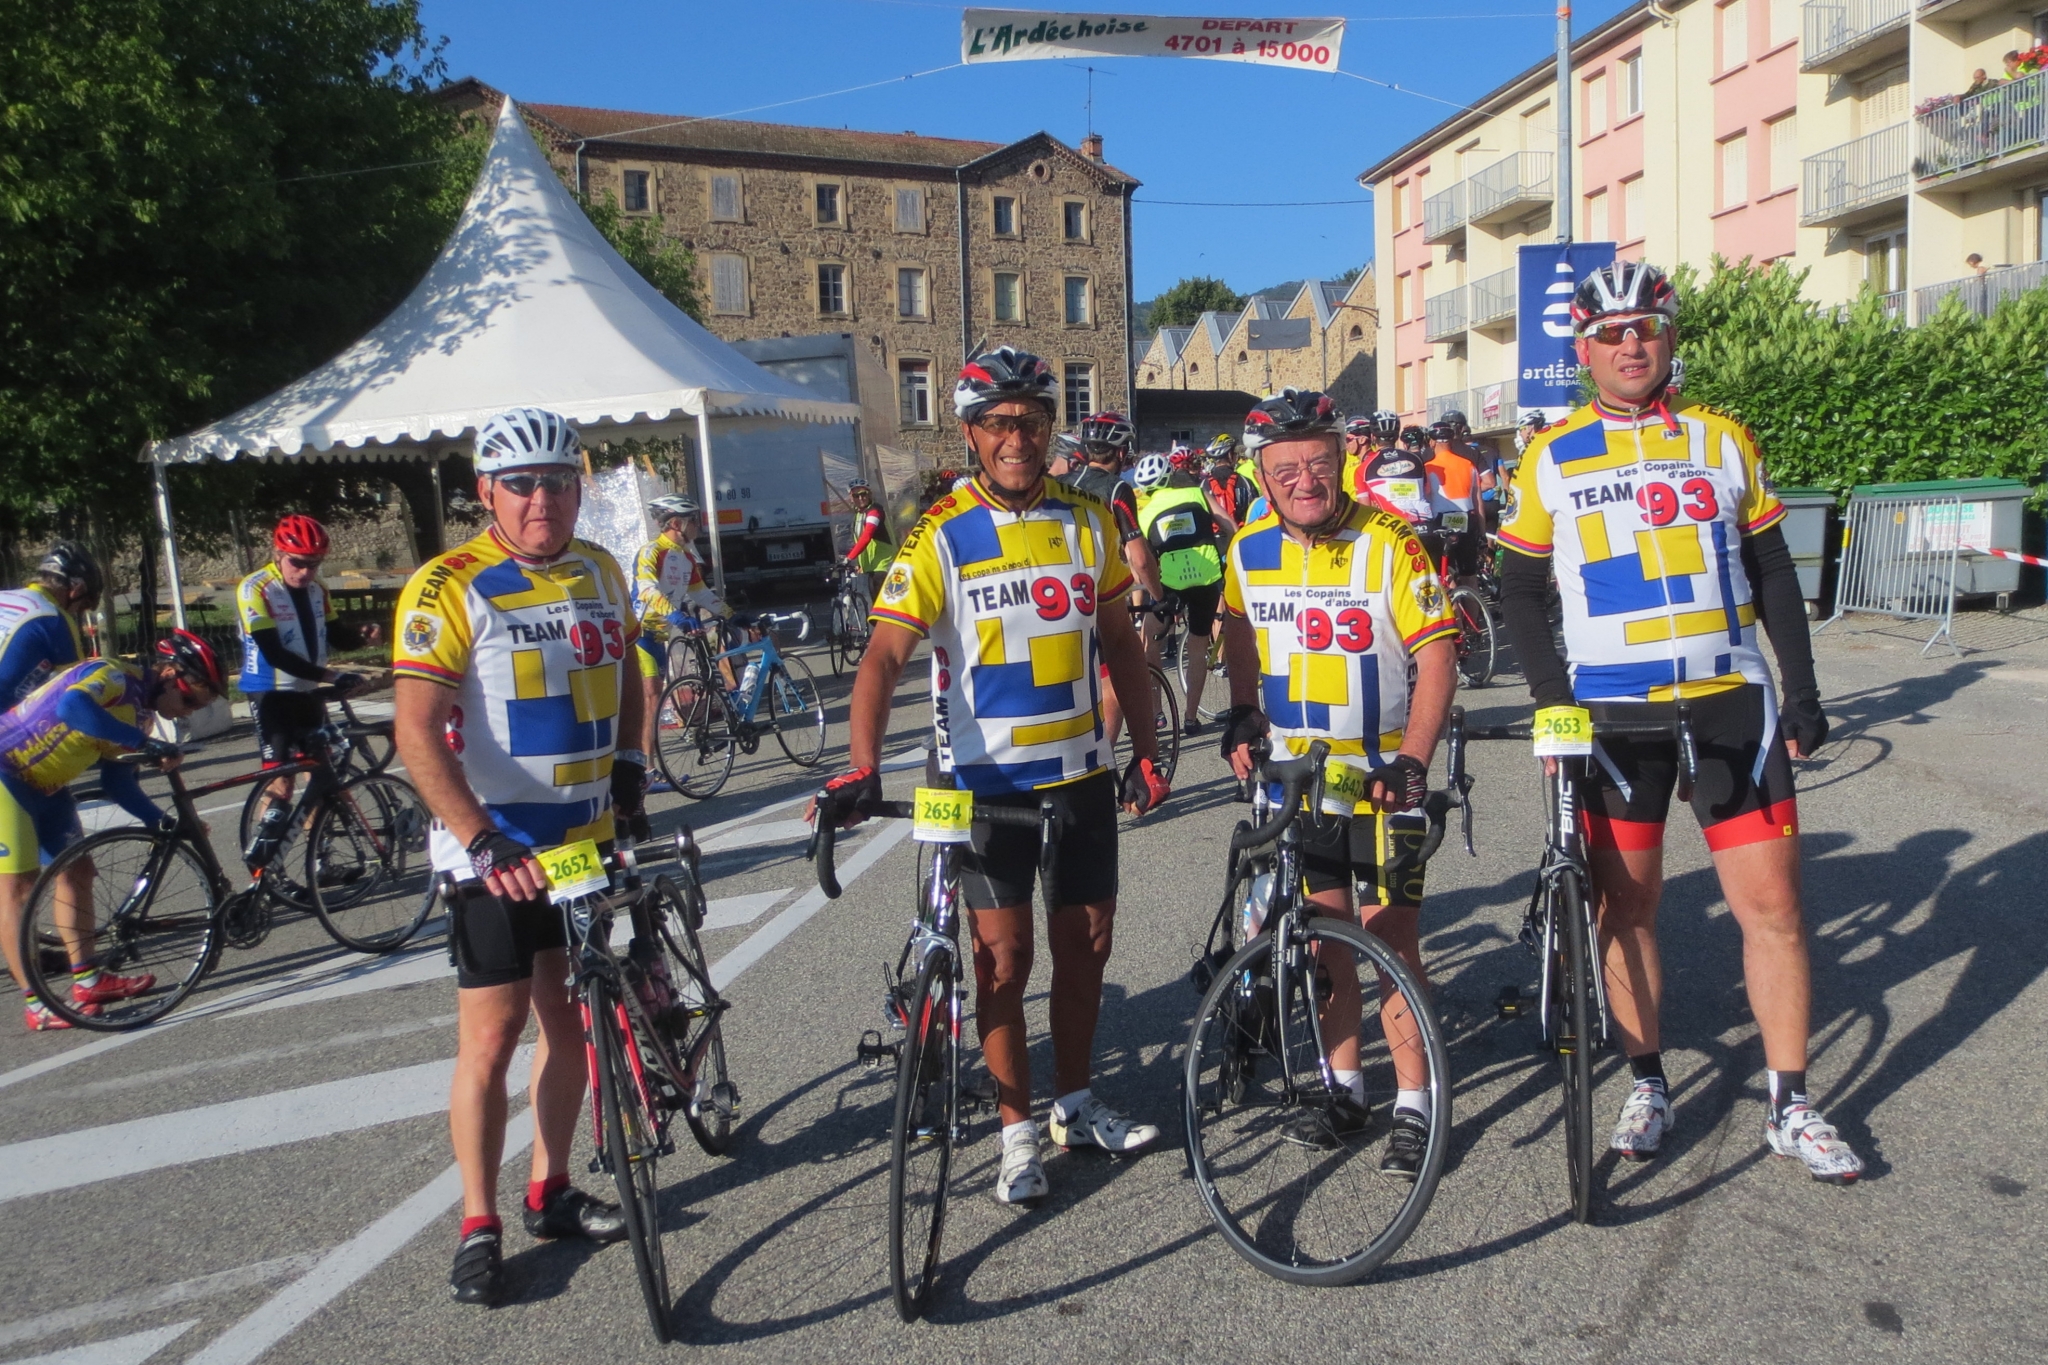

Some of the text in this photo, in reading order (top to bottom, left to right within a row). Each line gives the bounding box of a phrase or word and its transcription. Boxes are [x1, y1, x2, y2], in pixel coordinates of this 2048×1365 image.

[969, 18, 1150, 56] L'Ardéchoise
[1202, 20, 1299, 34] DEPART
[1164, 35, 1330, 65] 4701 à 15000
[1698, 402, 1745, 428] TEAM
[1616, 468, 1639, 478] Les
[1057, 481, 1101, 505] TEAM
[1569, 477, 1720, 527] TEAM 93
[898, 494, 957, 559] TEAM 93
[1369, 510, 1408, 541] TEAM
[1405, 538, 1427, 573] 93
[416, 552, 479, 610] TEAM 93
[1284, 589, 1352, 600] Les Copains
[547, 604, 569, 616] Les
[967, 572, 1095, 621] TEAM 93
[1325, 598, 1370, 608] d'abord
[1251, 602, 1375, 654] TEAM 93
[507, 619, 625, 667] TEAM 93
[936, 696, 951, 764] TEAM
[1544, 717, 1581, 735] 2653
[923, 801, 962, 821] 2654
[550, 853, 593, 881] 2652
